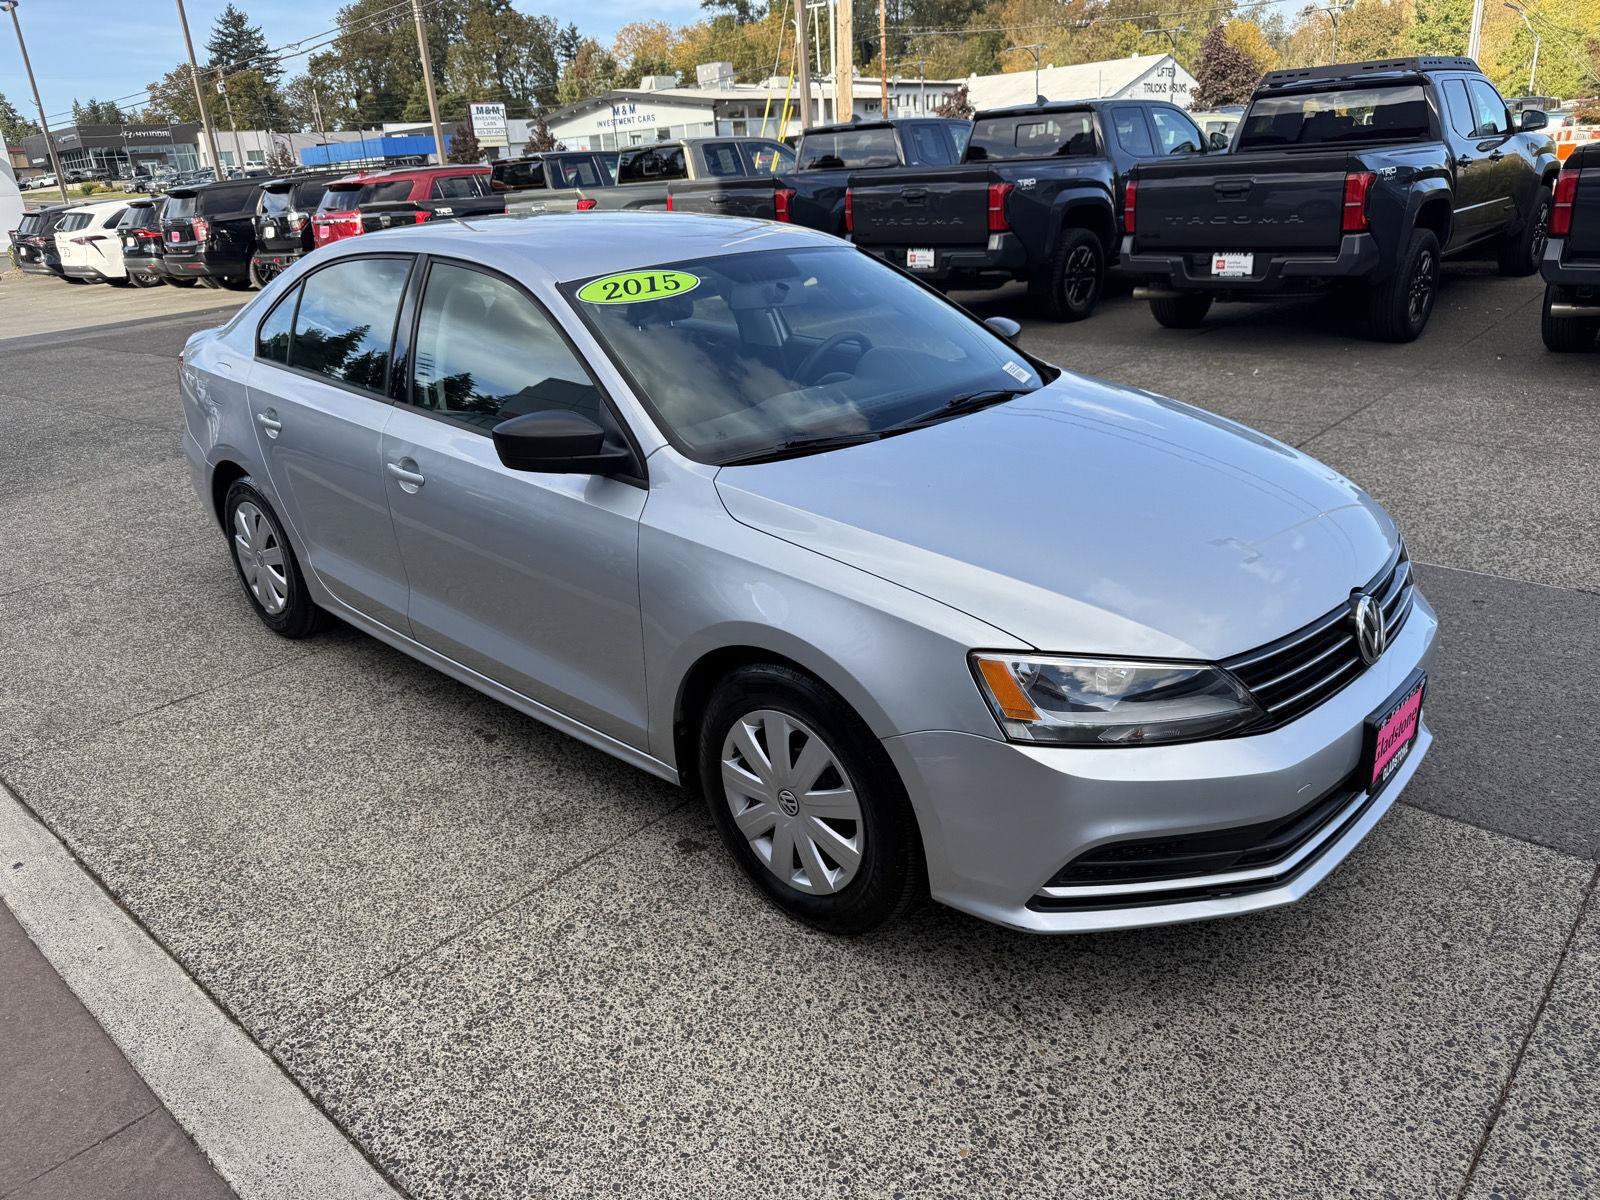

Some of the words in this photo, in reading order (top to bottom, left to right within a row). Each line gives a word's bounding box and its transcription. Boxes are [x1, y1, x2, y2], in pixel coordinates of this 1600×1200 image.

[1143, 83, 1166, 93] TRUCKS
[597, 117, 635, 128] INVESTMENT
[638, 114, 656, 123] CARS
[1380, 166, 1397, 176] TRD
[1017, 178, 1036, 187] TRD
[872, 217, 963, 225] TACOMA
[1165, 214, 1304, 225] TACOMA
[602, 274, 681, 300] 2015
